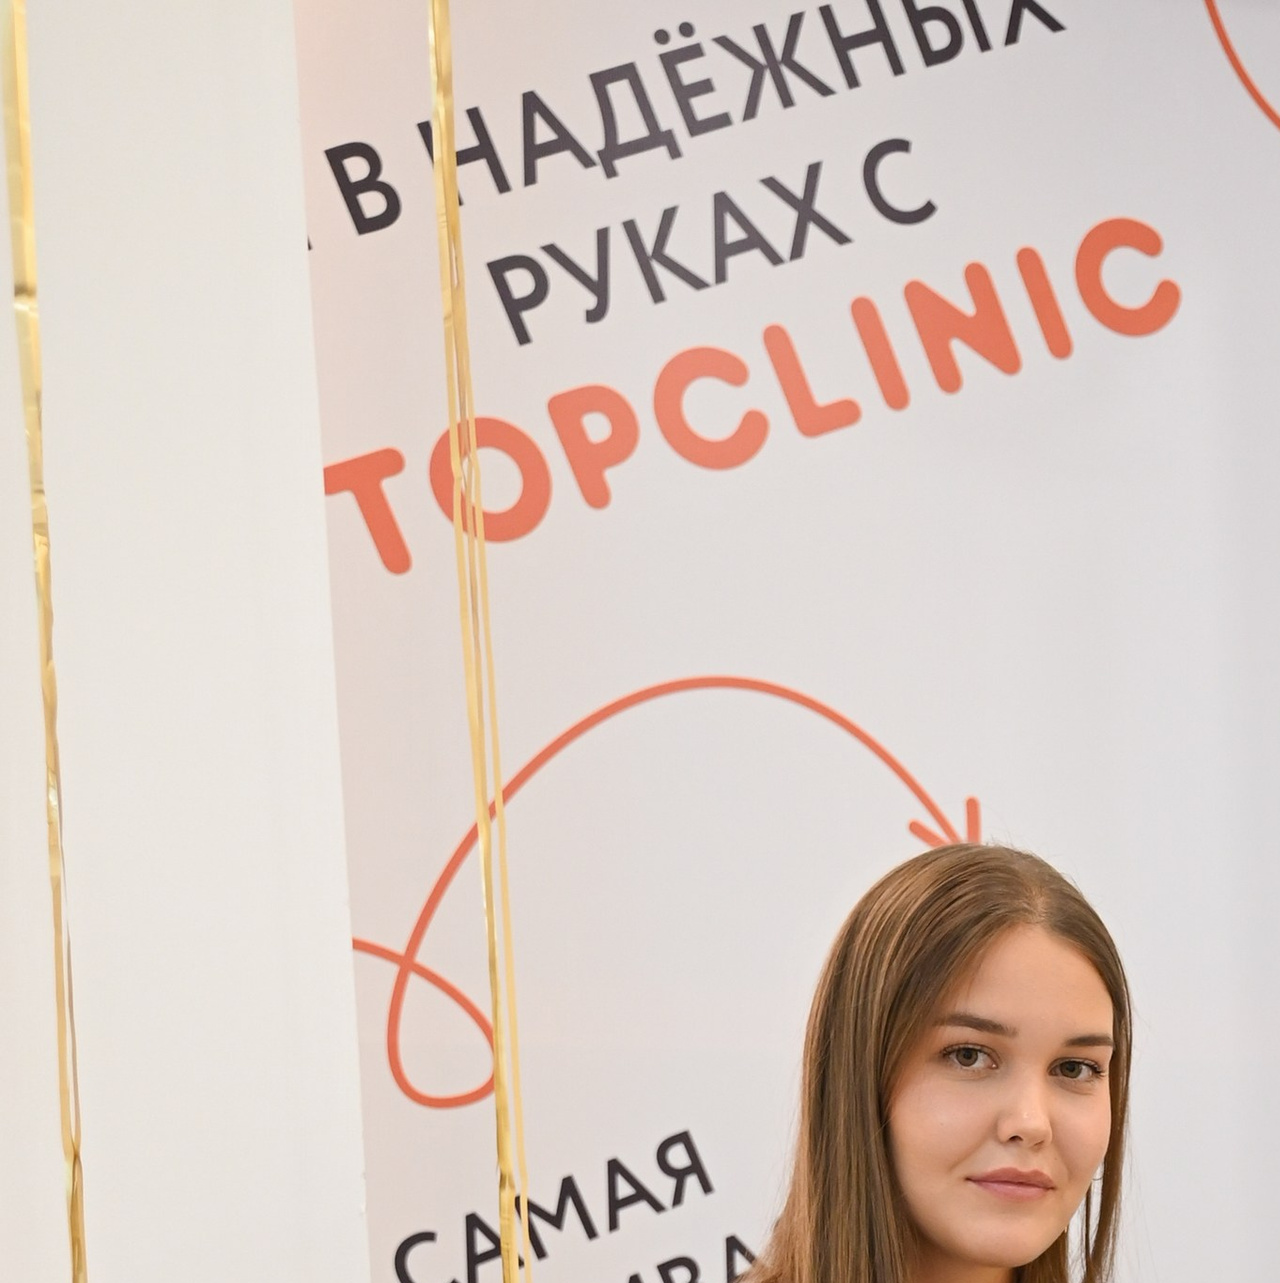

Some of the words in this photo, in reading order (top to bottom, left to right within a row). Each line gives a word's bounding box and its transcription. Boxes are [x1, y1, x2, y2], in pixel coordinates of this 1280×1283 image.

[324, 141, 402, 236] В
[486, 161, 852, 347] РУКАХ
[862, 137, 938, 226] С
[323, 217, 1182, 577] TOPCLINIC
